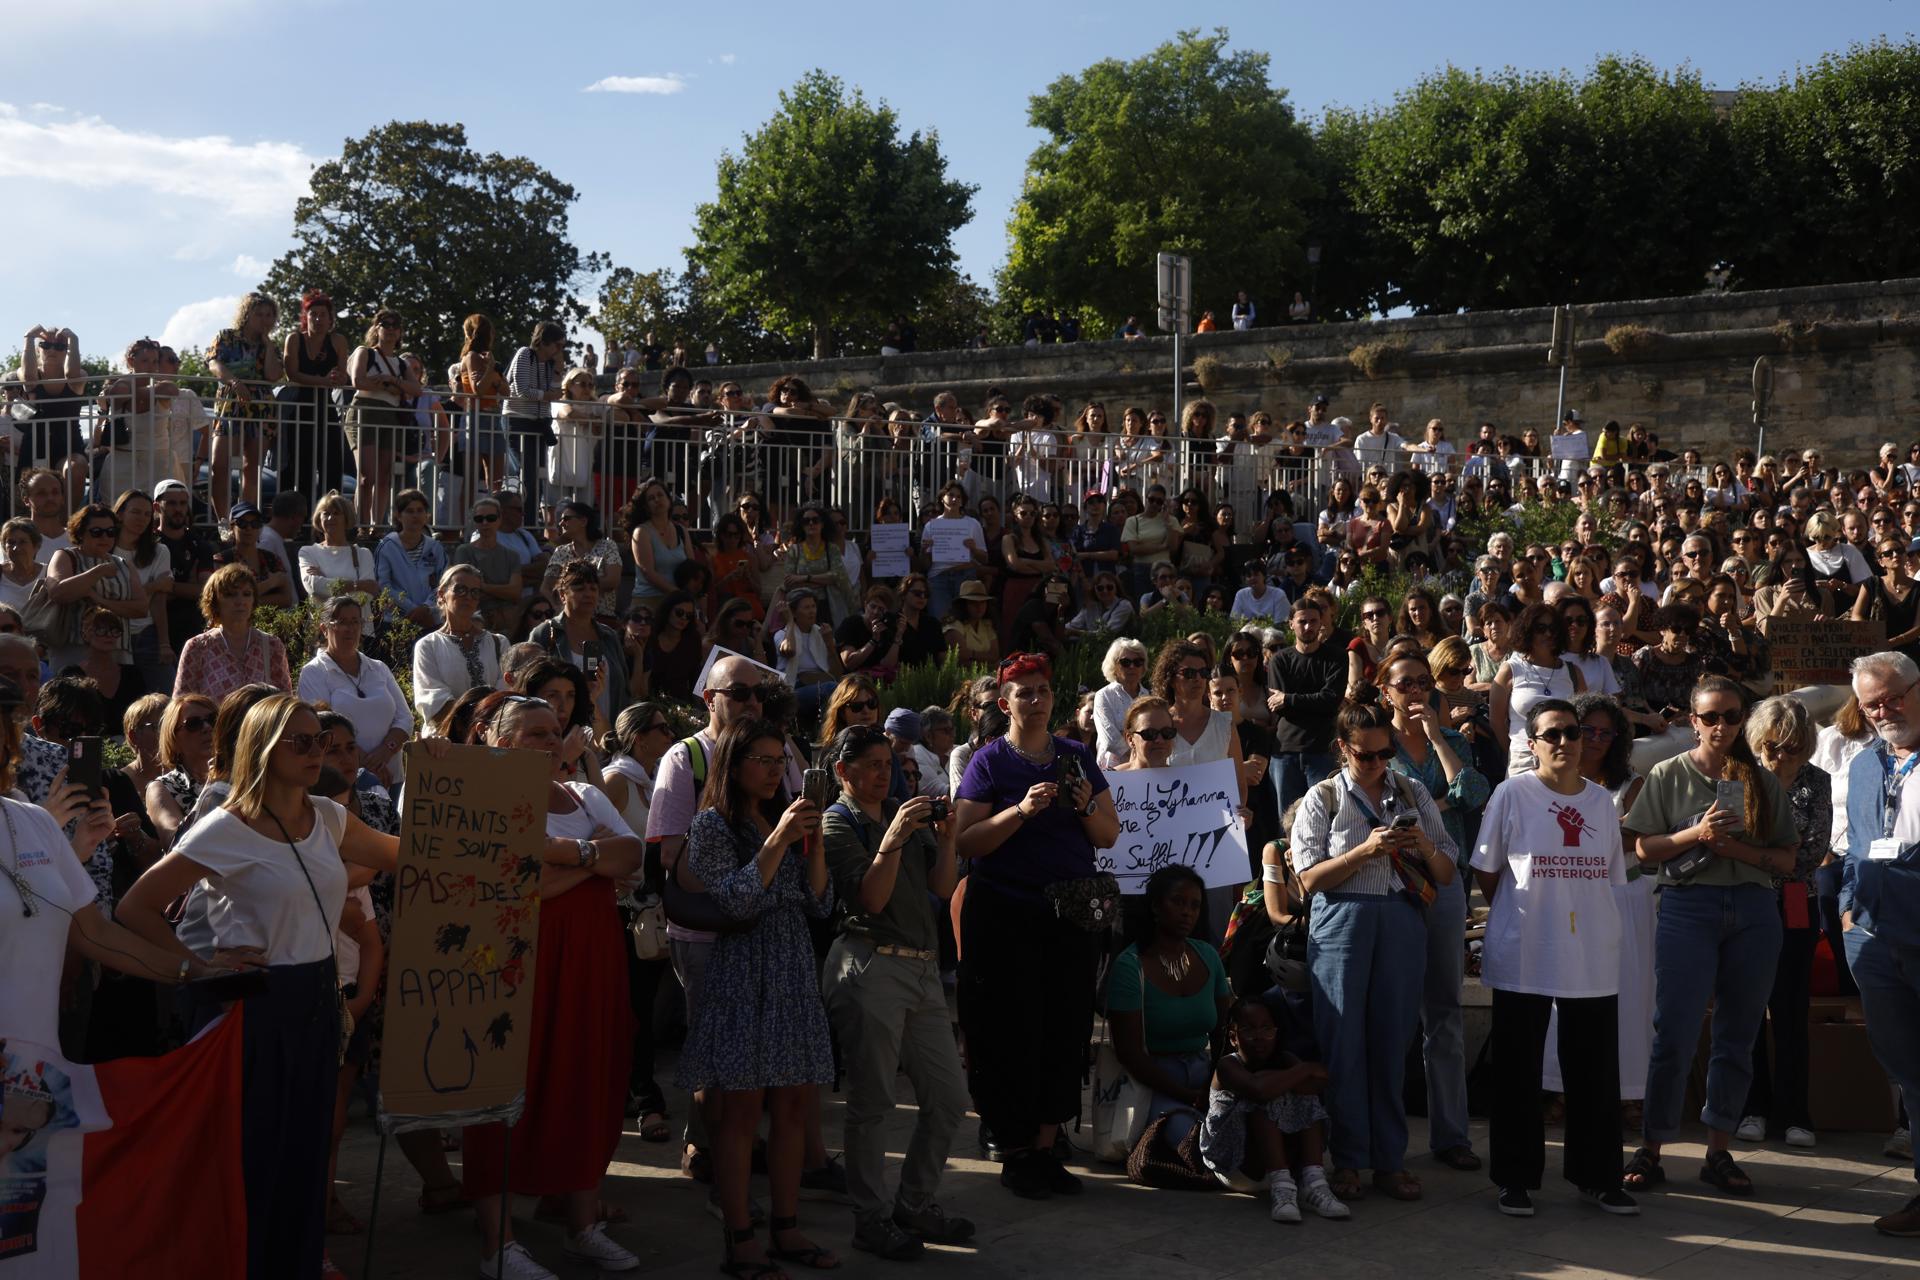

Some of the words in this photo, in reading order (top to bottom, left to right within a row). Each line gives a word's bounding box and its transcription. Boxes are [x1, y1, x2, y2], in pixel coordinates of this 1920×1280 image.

[419, 772, 464, 796] NOS
[1141, 783, 1158, 811] de
[1157, 779, 1228, 818] Lyhanna
[412, 799, 508, 834] ENFANTS
[412, 833, 444, 859] NE
[454, 838, 507, 863] SONT
[1126, 839, 1177, 873] Suffit
[1532, 856, 1606, 866] TRICOTEUSE
[399, 864, 452, 918] PAS
[477, 880, 523, 902] DES
[1532, 868, 1608, 880] HYSTERIQUE
[399, 965, 518, 1007] APPATS
